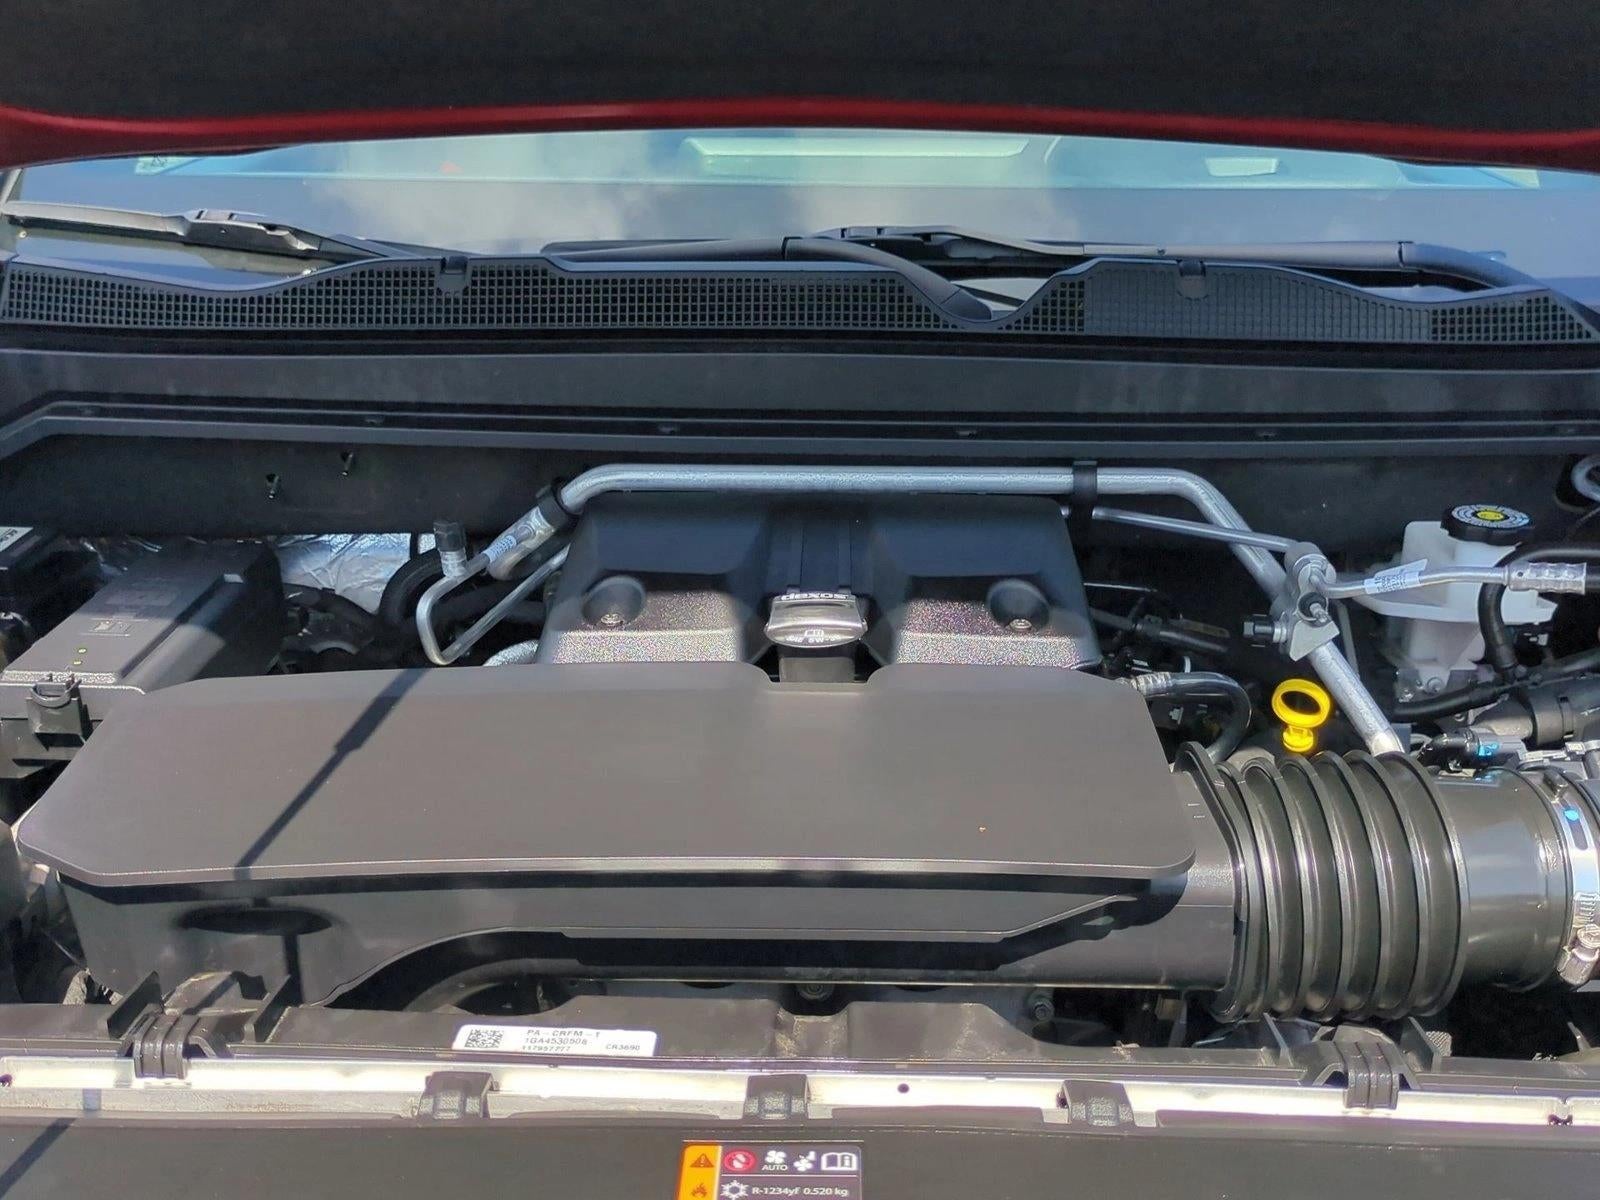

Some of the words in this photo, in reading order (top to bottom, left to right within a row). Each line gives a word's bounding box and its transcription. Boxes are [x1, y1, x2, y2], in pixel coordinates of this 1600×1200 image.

[751, 1186, 801, 1197] R-1234yf
[803, 1187, 833, 1196] 0.520
[834, 1187, 849, 1198] kg
